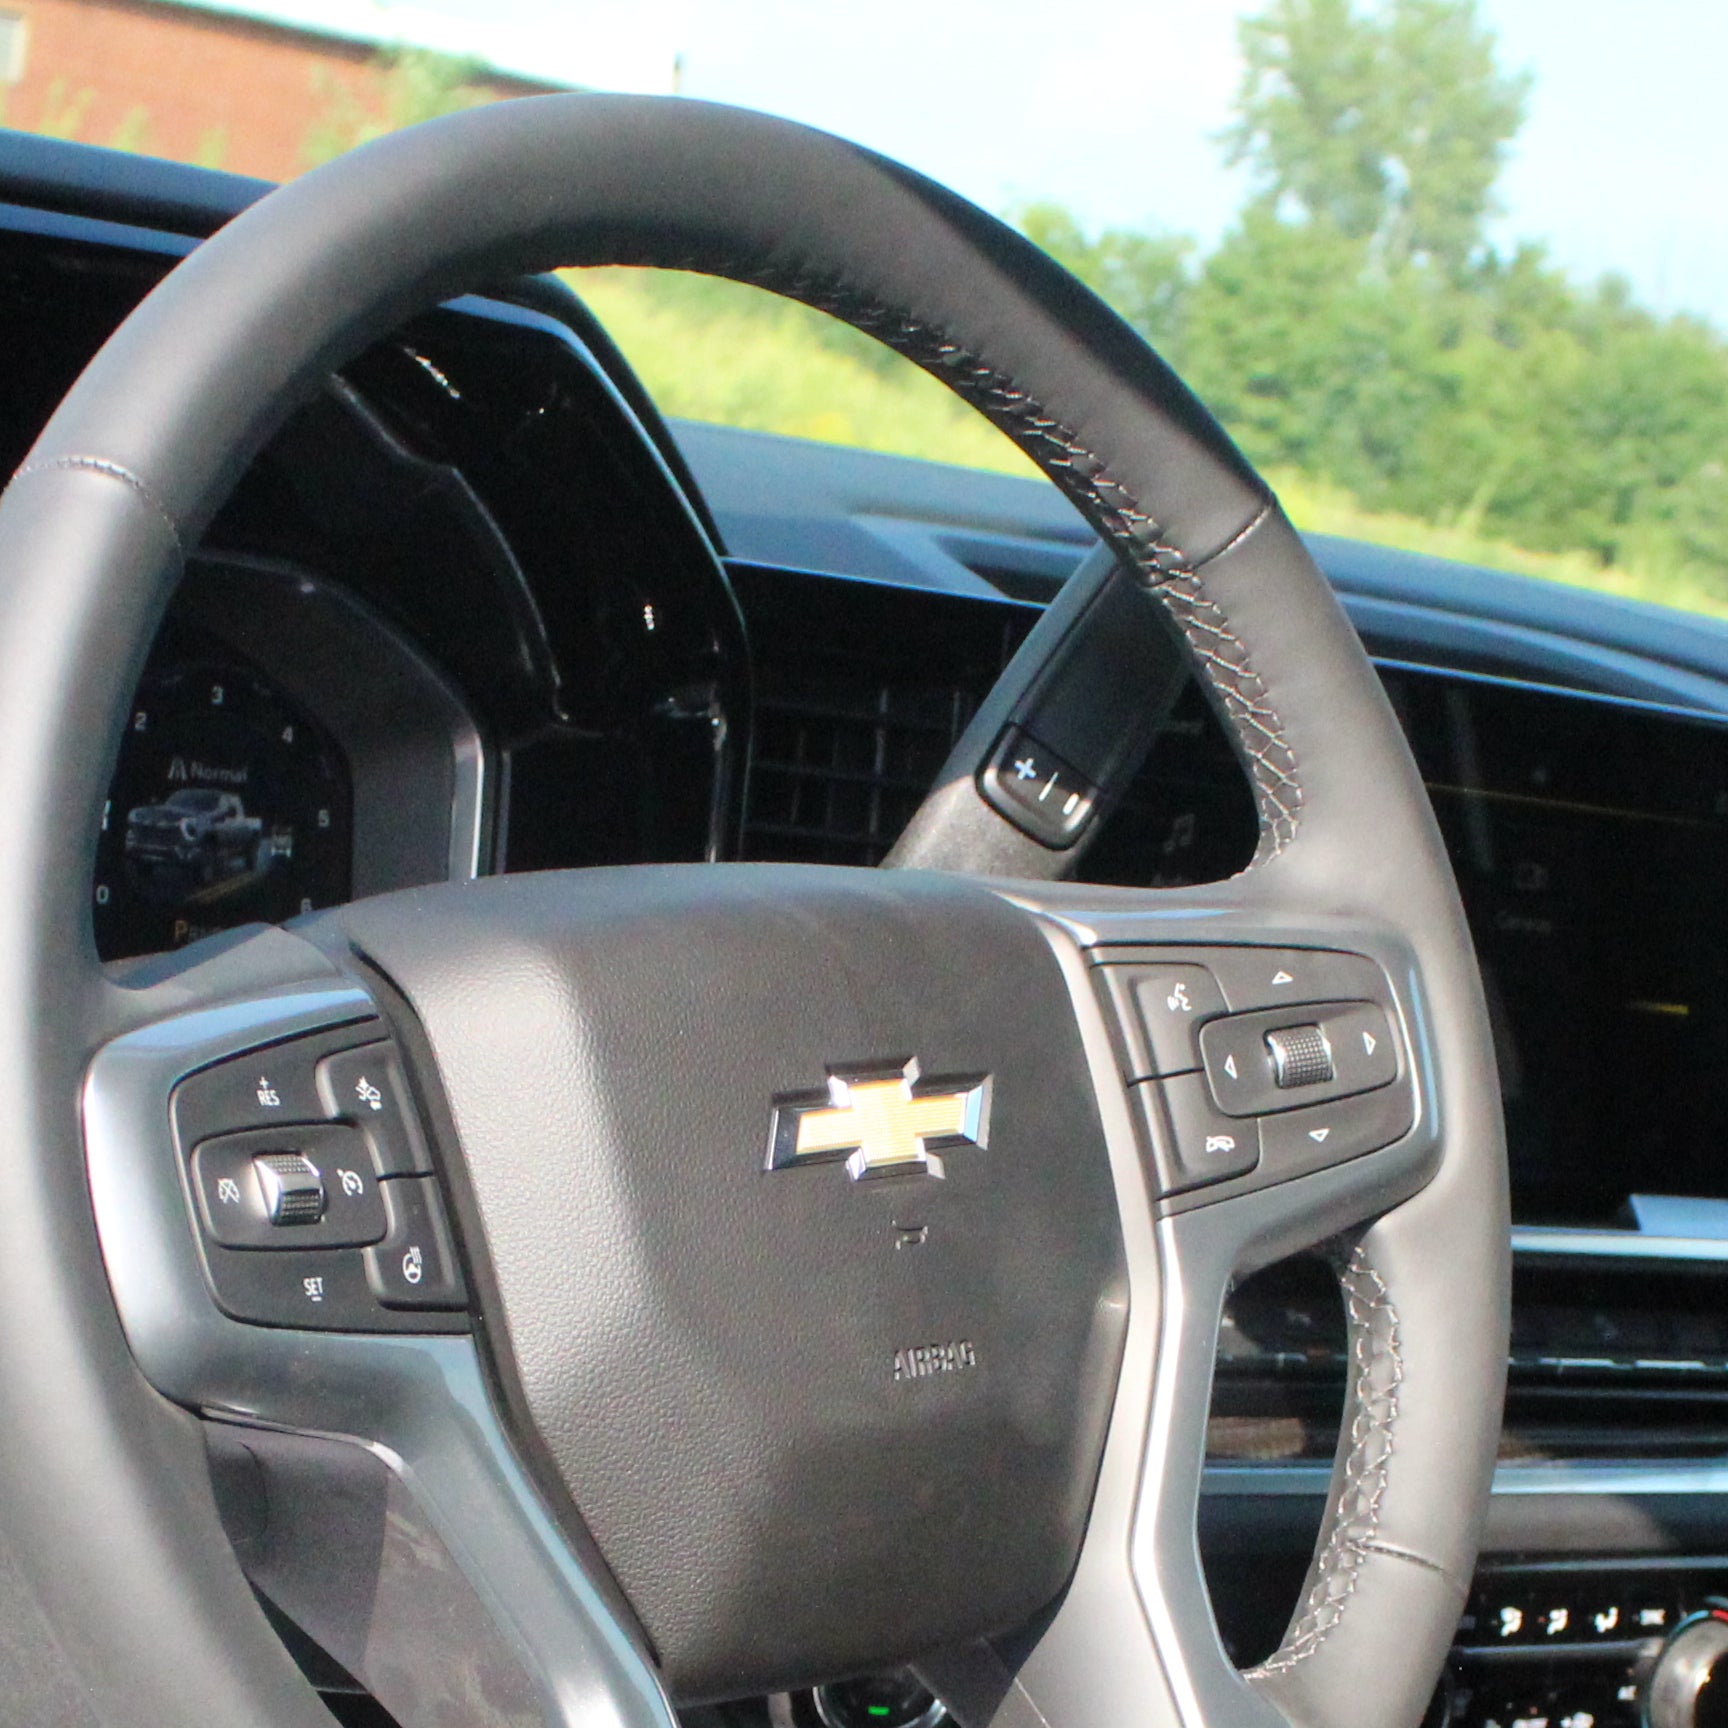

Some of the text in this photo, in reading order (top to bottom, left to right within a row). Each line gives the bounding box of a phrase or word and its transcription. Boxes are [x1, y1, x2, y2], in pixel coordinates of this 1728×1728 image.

[211, 685, 223, 704] 3
[134, 711, 147, 731] 2
[281, 725, 294, 743] 4
[95, 885, 109, 904] 0
[256, 1089, 280, 1106] RES
[303, 1277, 323, 1296] SET
[893, 1339, 976, 1381] AIRBAG
